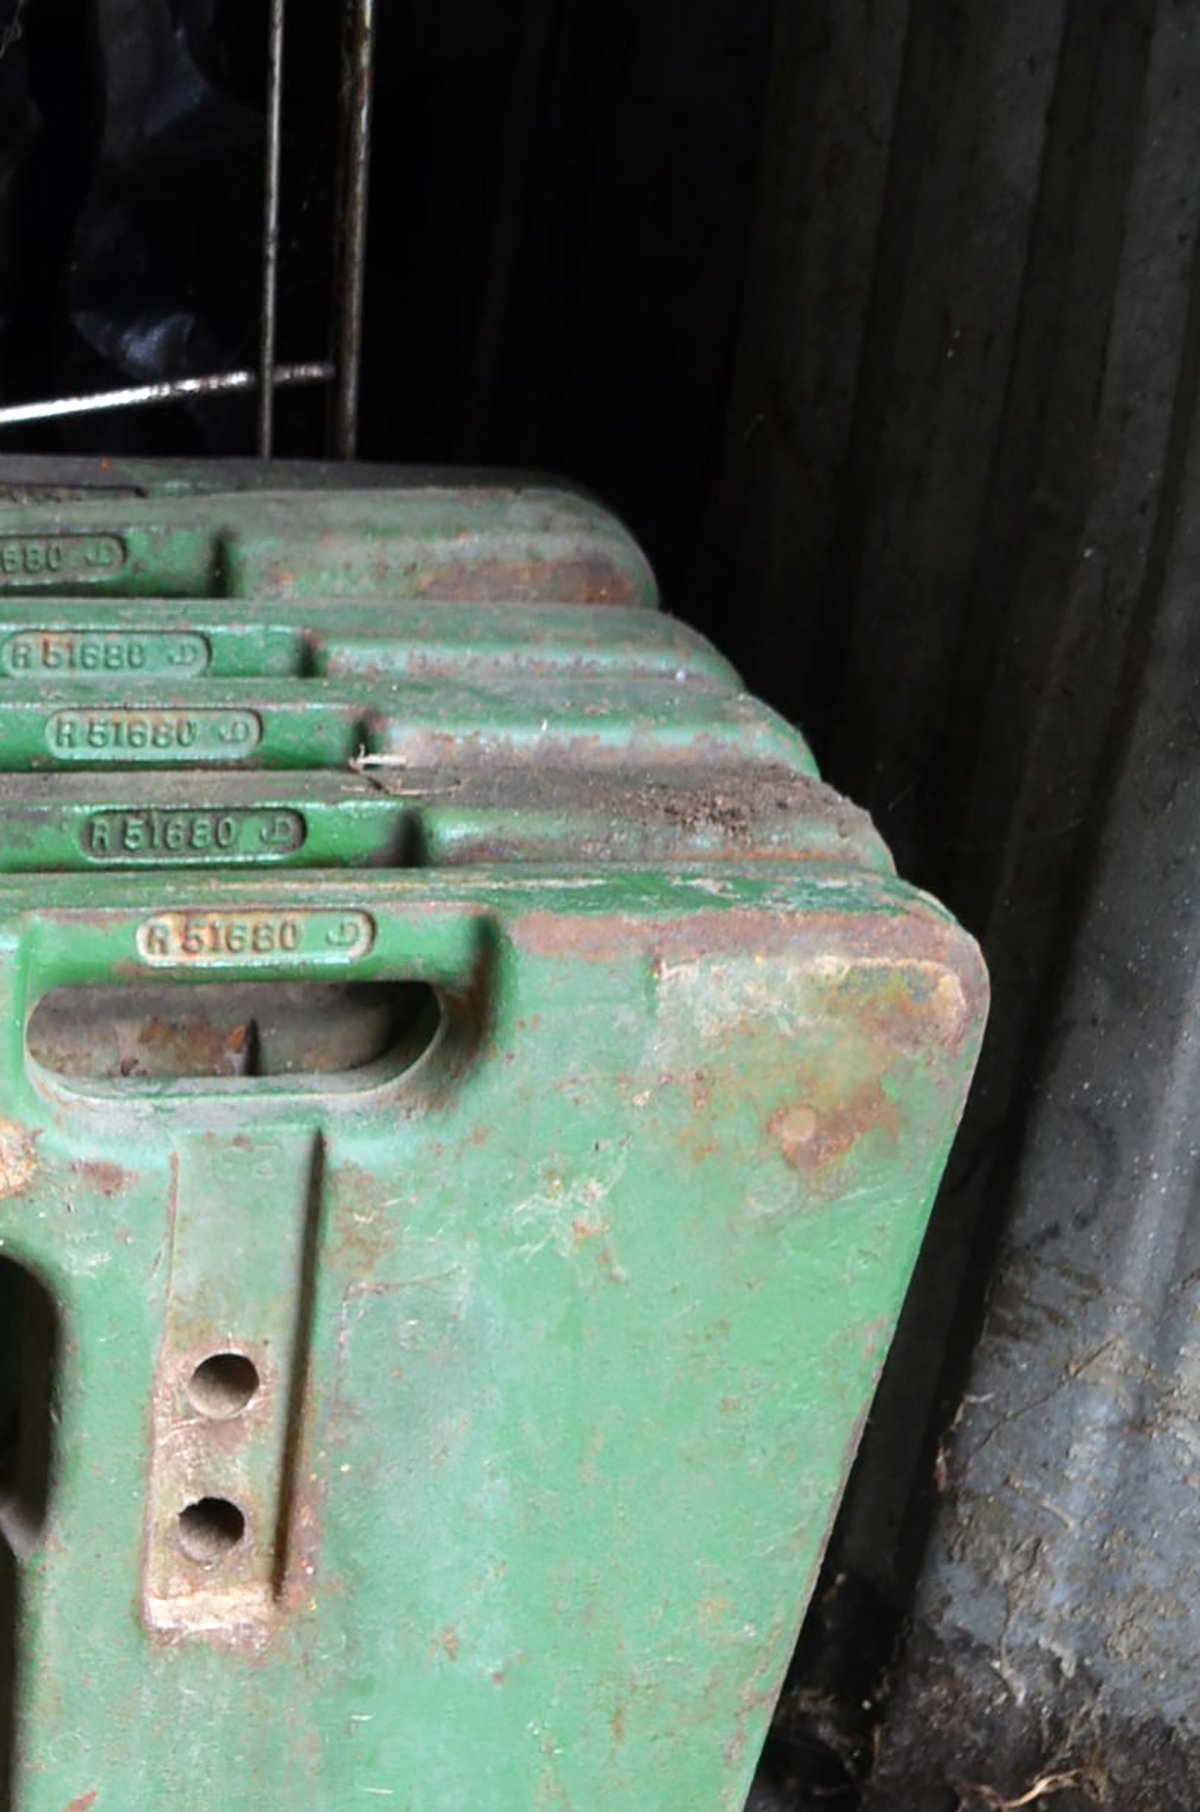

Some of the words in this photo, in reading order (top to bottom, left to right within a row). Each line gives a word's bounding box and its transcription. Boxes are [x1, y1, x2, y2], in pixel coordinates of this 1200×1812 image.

[11, 641, 31, 669] R
[55, 717, 75, 748] R
[91, 818, 109, 850] R
[123, 816, 235, 849] 51680
[147, 923, 169, 955] R
[180, 919, 298, 954] 51680
